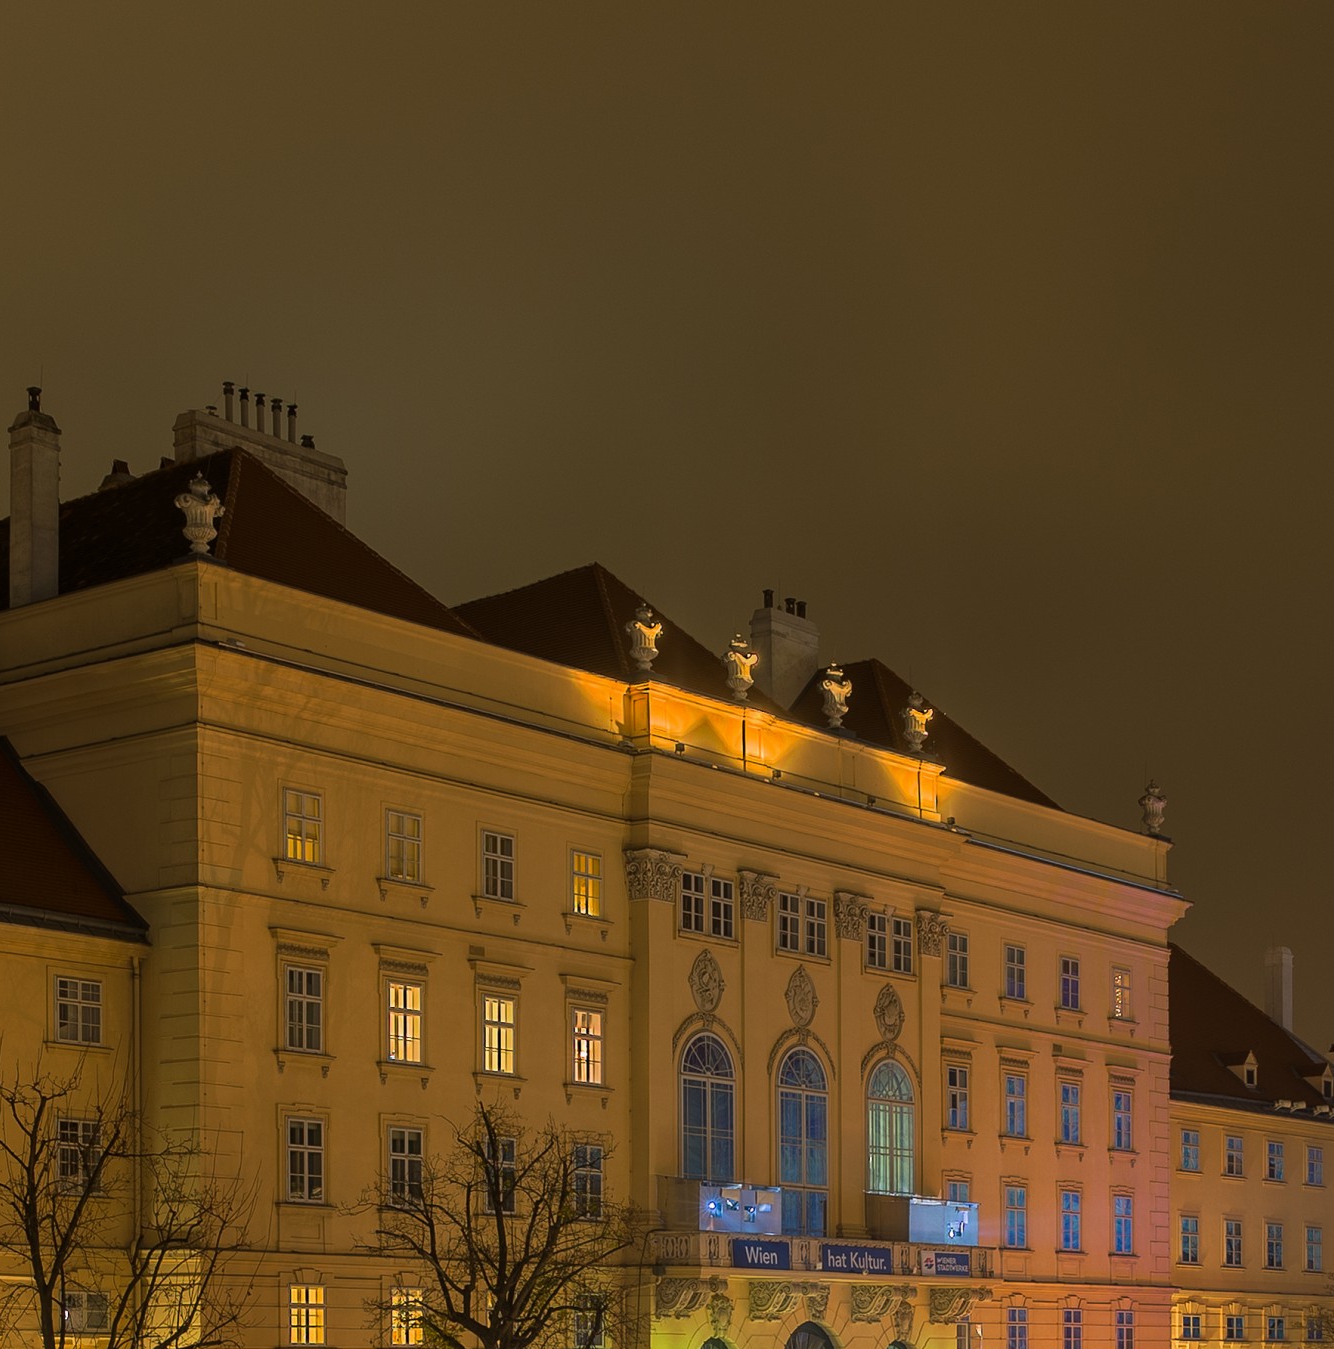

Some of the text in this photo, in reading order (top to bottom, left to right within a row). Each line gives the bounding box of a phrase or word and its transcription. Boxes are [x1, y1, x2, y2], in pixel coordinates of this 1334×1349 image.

[745, 1246, 778, 1265] Wien
[827, 1249, 887, 1271] hat Kultur.
[936, 1257, 957, 1265] WIENER
[936, 1263, 970, 1273] STADTWERKE
